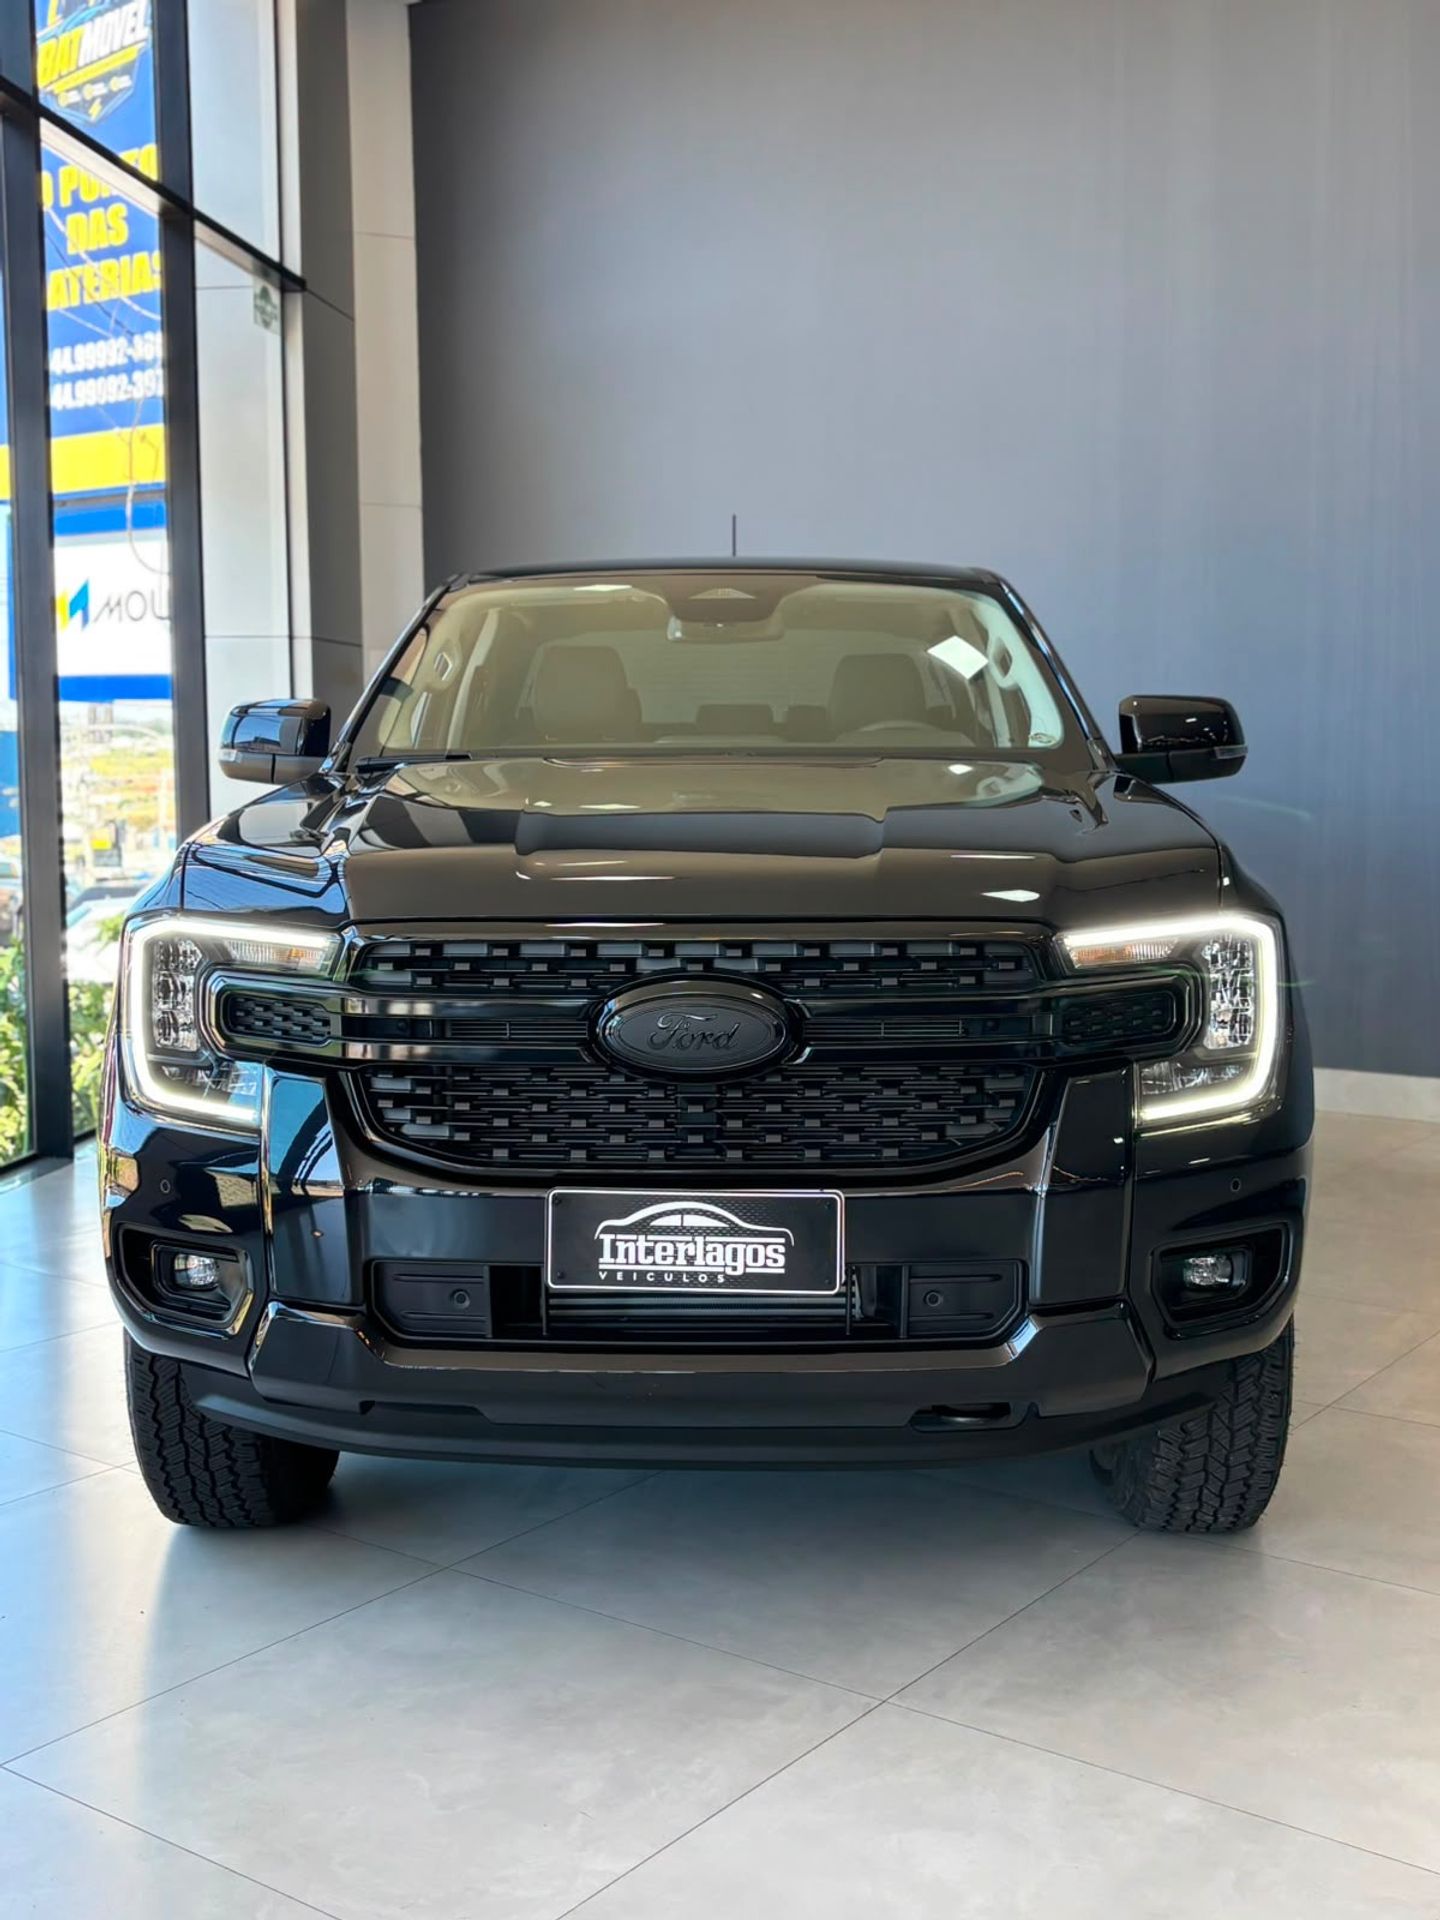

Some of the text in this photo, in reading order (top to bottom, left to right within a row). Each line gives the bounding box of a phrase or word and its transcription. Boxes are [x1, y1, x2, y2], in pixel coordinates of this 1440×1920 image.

[59, 143, 159, 208] POO
[66, 202, 129, 256] DAS
[648, 1012, 740, 1050] Ford
[599, 1233, 786, 1276] Interlagos
[598, 1271, 726, 1284] VEICULOS
